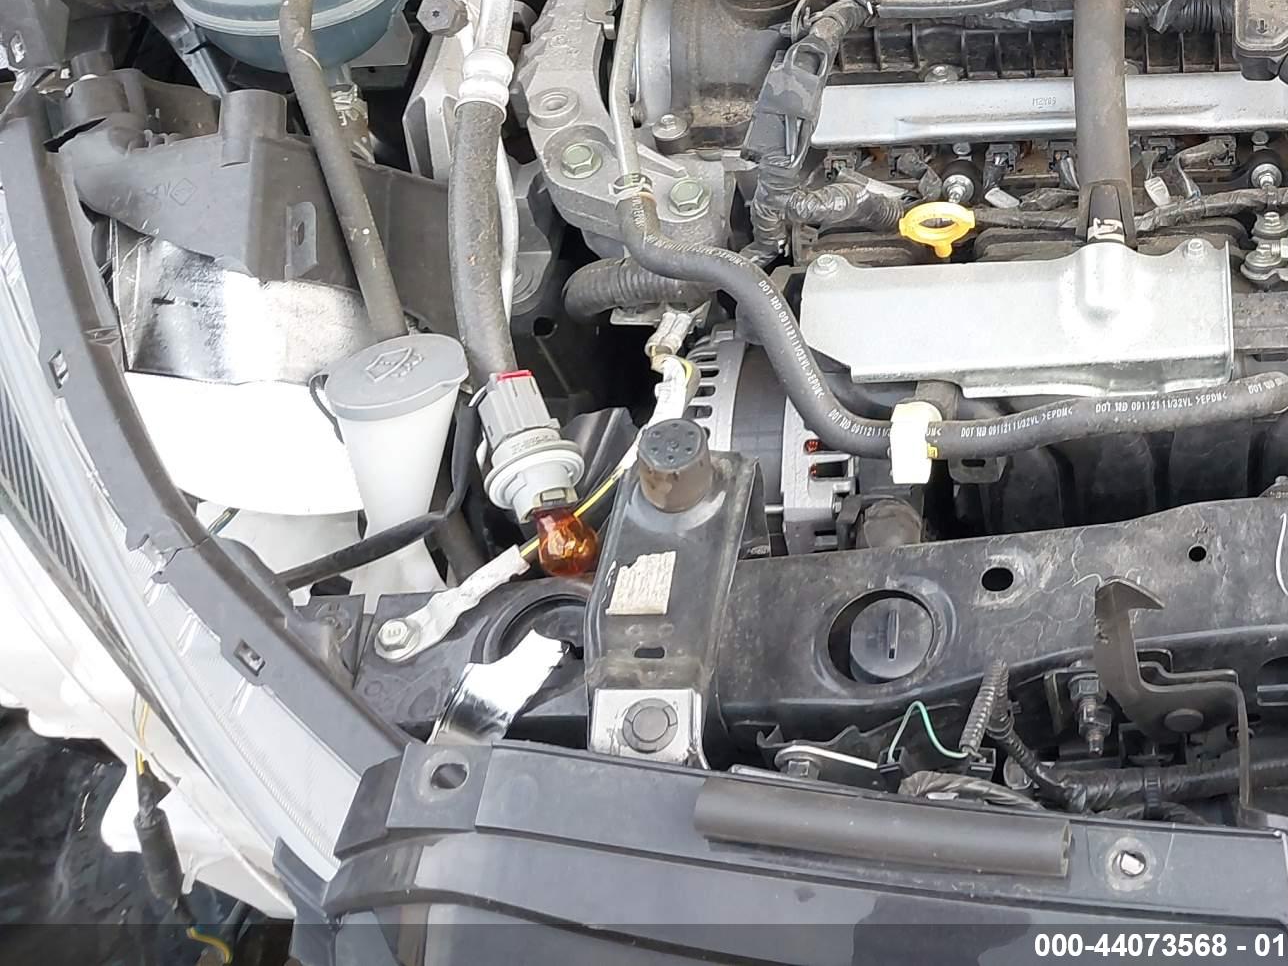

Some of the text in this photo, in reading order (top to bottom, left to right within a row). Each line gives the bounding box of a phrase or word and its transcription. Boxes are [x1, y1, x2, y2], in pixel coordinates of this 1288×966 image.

[758, 280, 774, 296] DOT
[1095, 401, 1111, 413] DOT
[960, 426, 974, 438] DOT
